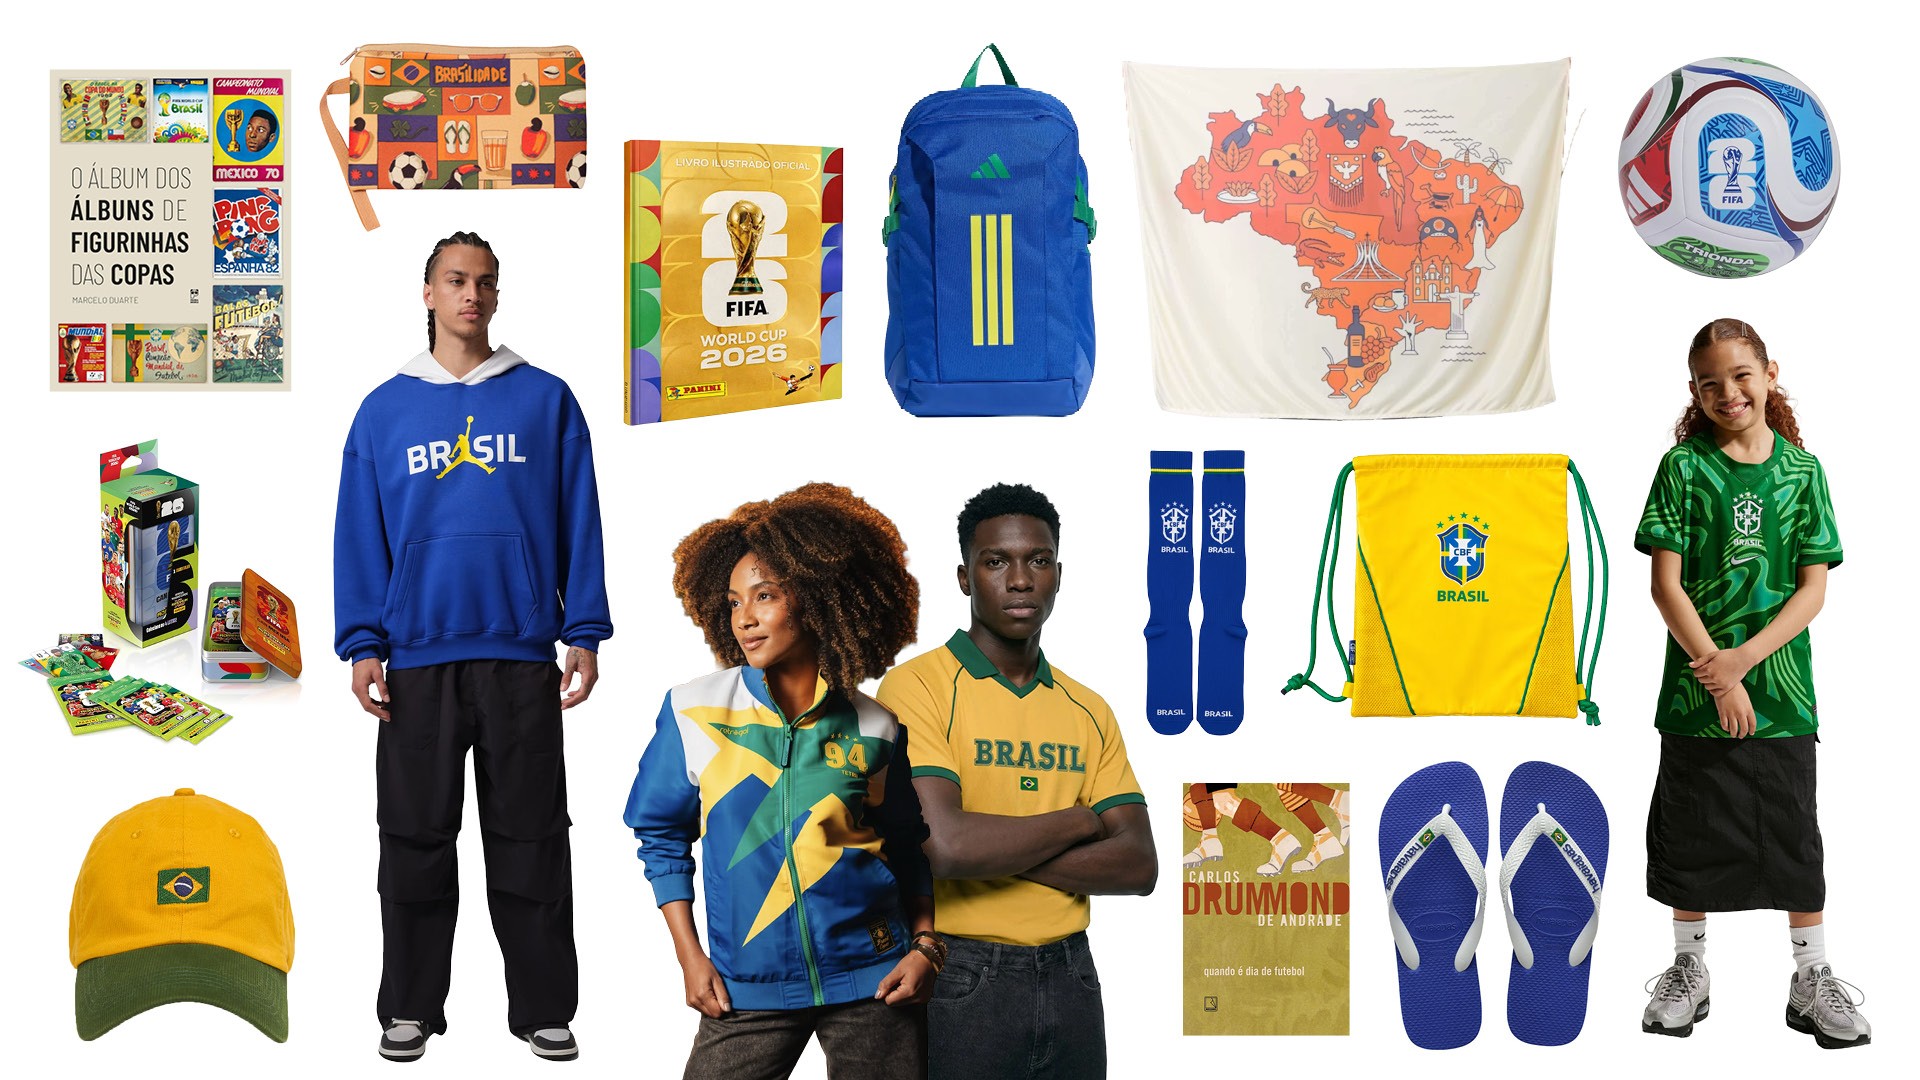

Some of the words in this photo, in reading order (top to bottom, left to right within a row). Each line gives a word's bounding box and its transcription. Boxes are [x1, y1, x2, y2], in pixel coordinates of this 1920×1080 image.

[171, 103, 203, 113] Brasil
[676, 158, 709, 167] LIVRO
[712, 160, 771, 168] ILUSTRADO
[773, 162, 810, 170] OFICIAL
[72, 167, 82, 189] O
[88, 162, 148, 189] ÁLBUM
[156, 167, 191, 189] DOS
[266, 168, 280, 179] 70
[70, 194, 153, 221] ÁLBUNS
[164, 199, 186, 221] DE
[214, 196, 271, 220] PING
[72, 232, 189, 253] FIGURINHAS
[1684, 242, 1754, 265] TRIONDA
[72, 263, 104, 285] DAS
[112, 263, 174, 285] COPAS
[215, 300, 249, 314] BALAS
[726, 300, 767, 317] FIFA
[701, 332, 756, 347] WORLD
[759, 329, 787, 341] CUP
[700, 344, 787, 370] 2026
[684, 384, 721, 394] PANINI
[1734, 538, 1762, 546] BRASIL
[1454, 548, 1471, 556] CBF
[1437, 590, 1489, 602] BRASIL
[825, 741, 869, 774] 94
[974, 738, 1086, 774] BRASIL
[1189, 871, 1240, 883] CARLOS
[1562, 844, 1600, 893] havaianas
[1183, 882, 1350, 915] DRUMMOND
[1258, 914, 1274, 926] DE
[1280, 914, 1341, 926] ANDRADE
[1204, 967, 1235, 978] quando
[1238, 966, 1243, 976] é
[1246, 966, 1259, 976] dia
[1262, 966, 1272, 976] de
[1274, 966, 1304, 976] futebol
